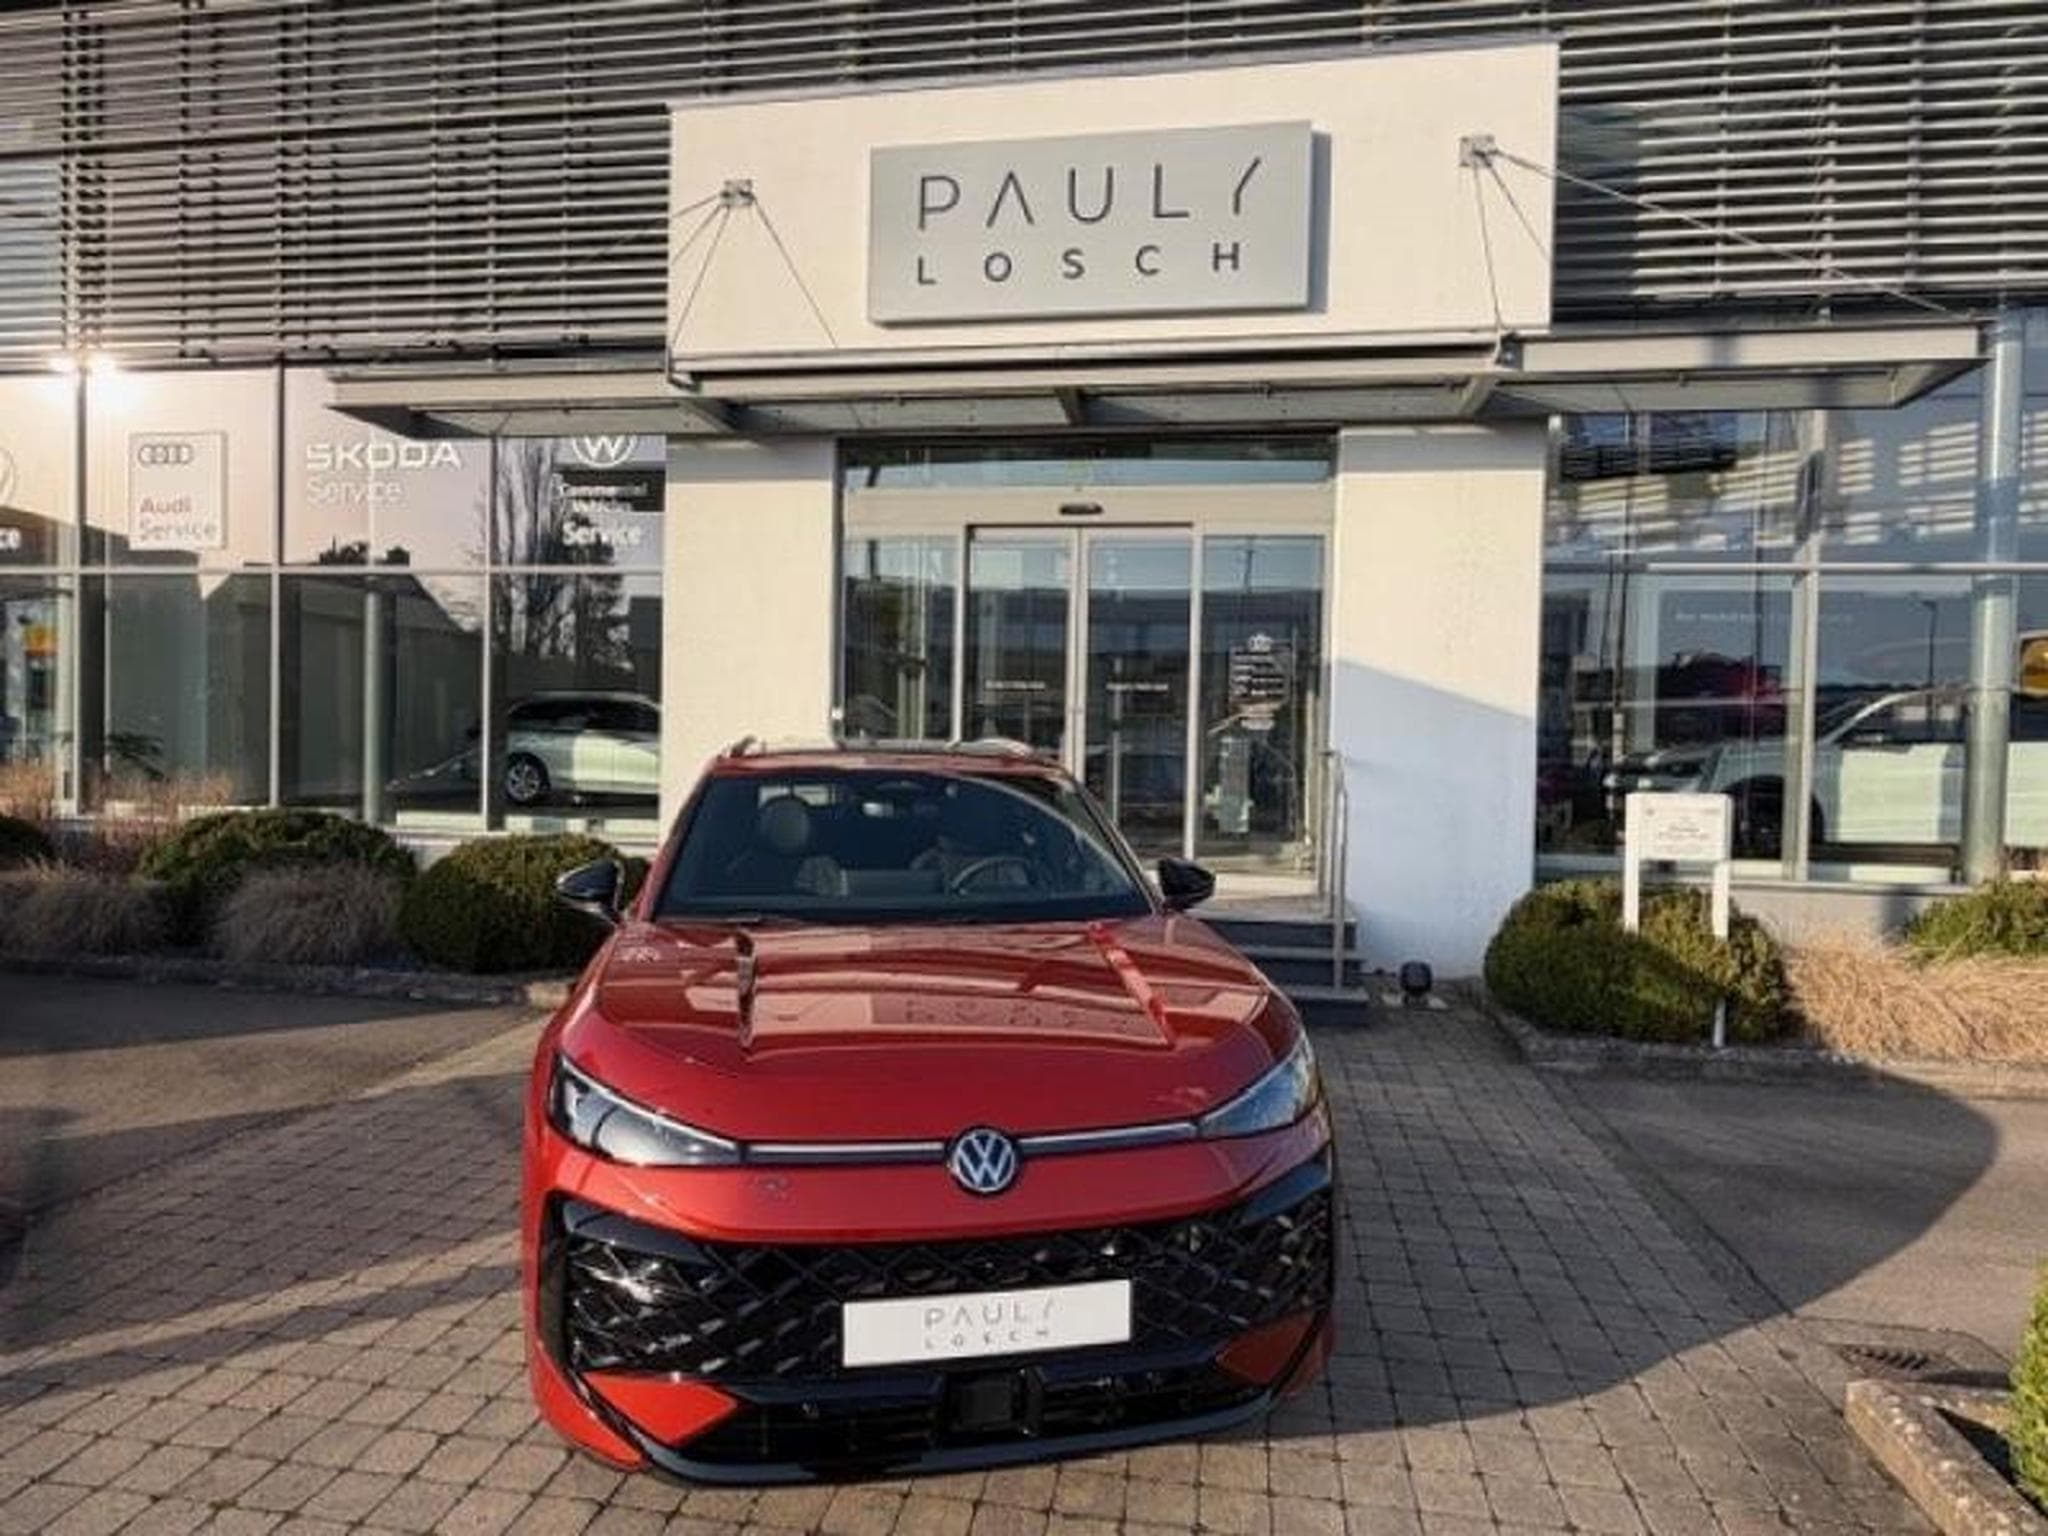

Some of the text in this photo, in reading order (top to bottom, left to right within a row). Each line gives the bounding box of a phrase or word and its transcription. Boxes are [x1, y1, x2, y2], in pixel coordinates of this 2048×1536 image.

[917, 156, 1263, 232] PAULY
[916, 242, 1241, 286] LOSCH
[140, 497, 192, 514] Audi
[140, 517, 219, 542] Service
[562, 519, 642, 545] Service
